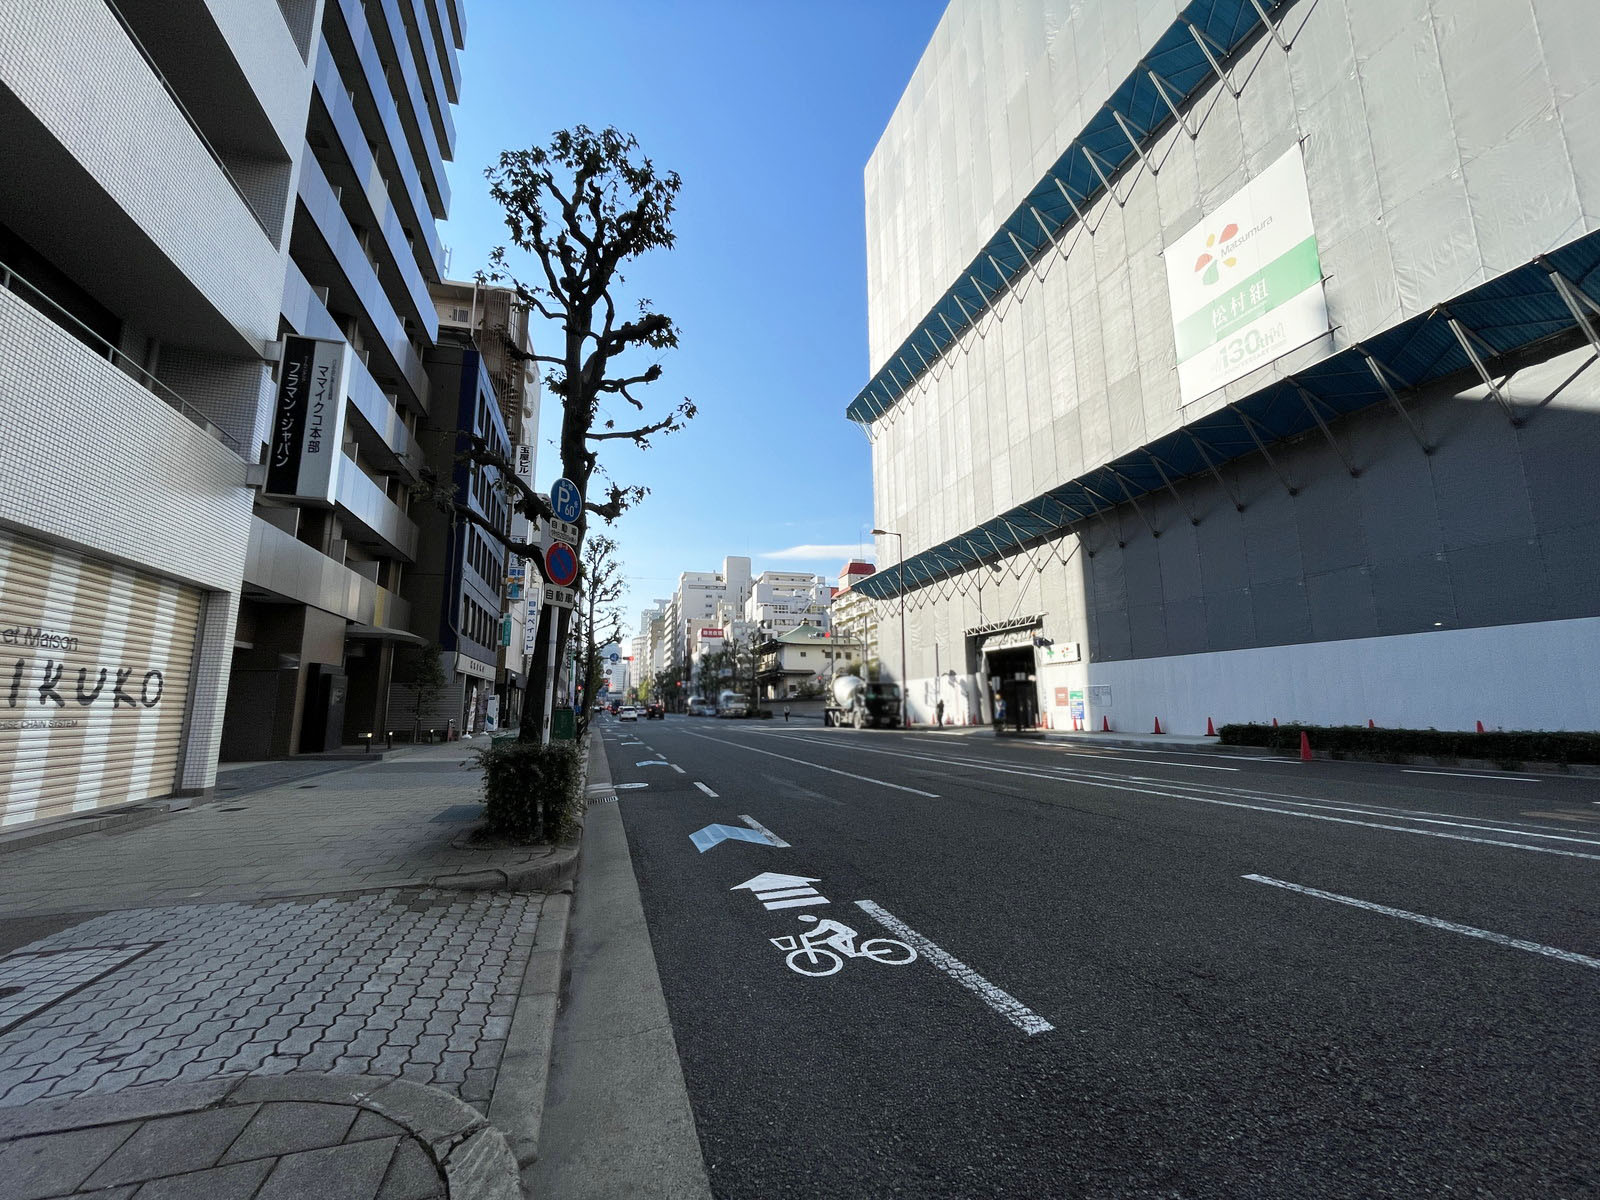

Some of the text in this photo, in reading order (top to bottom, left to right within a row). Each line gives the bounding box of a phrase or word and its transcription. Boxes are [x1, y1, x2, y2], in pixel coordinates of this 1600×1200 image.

[1220, 215, 1274, 257] Matsumura
[1211, 277, 1270, 329] 松村組
[276, 361, 301, 467] フラマン・ジャパン
[307, 365, 329, 454] ママイクコ本部
[519, 446, 531, 474] 玉屋ビル
[557, 486, 571, 513] P
[551, 520, 577, 535] 自動車
[545, 589, 574, 604] 自動車
[2, 626, 79, 651] et Maison
[526, 600, 536, 651] 日本ペイント
[8, 657, 165, 709] IKUKO
[21, 719, 47, 729] CHAIN
[48, 719, 78, 729] SYSTEM
